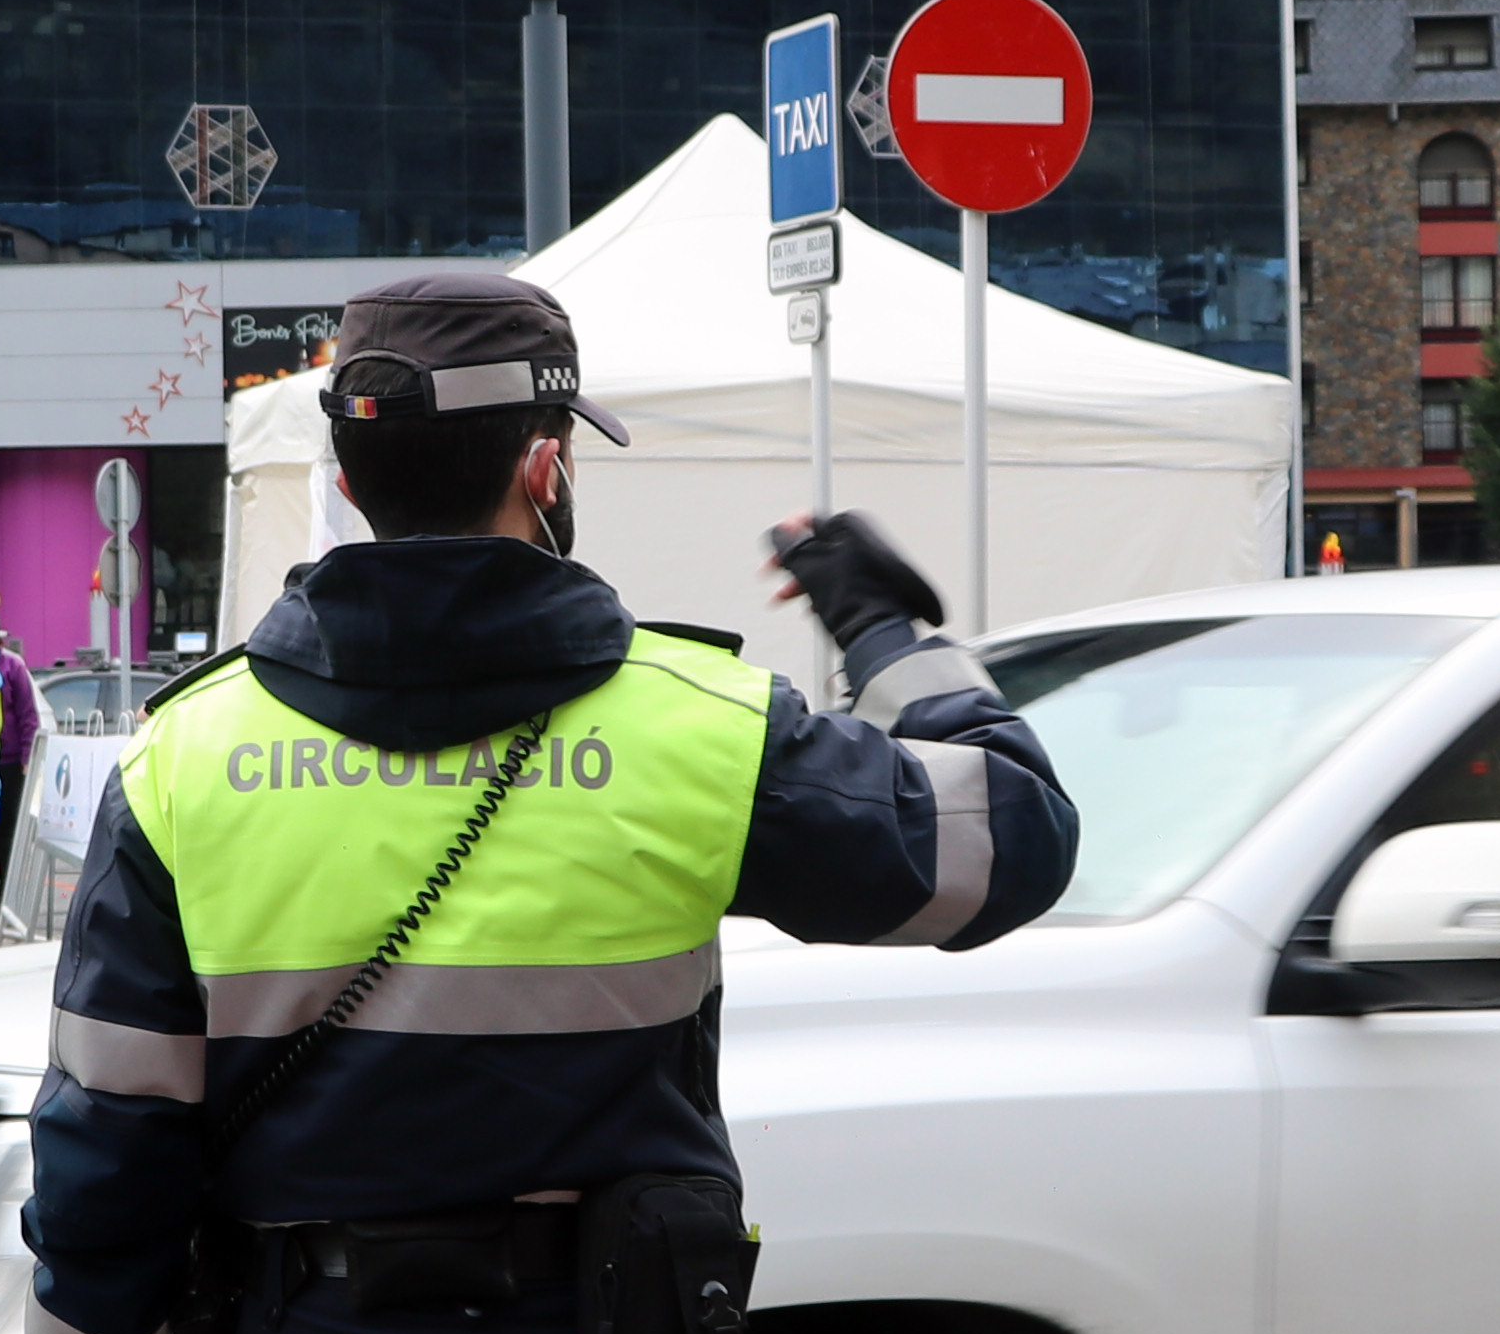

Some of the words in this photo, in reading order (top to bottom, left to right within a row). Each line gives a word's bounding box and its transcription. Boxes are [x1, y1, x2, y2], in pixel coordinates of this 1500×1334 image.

[773, 91, 829, 156] TAXI
[231, 314, 292, 346] Bones
[295, 311, 342, 346] Feste
[226, 726, 614, 793] CIRCULACIÓ
